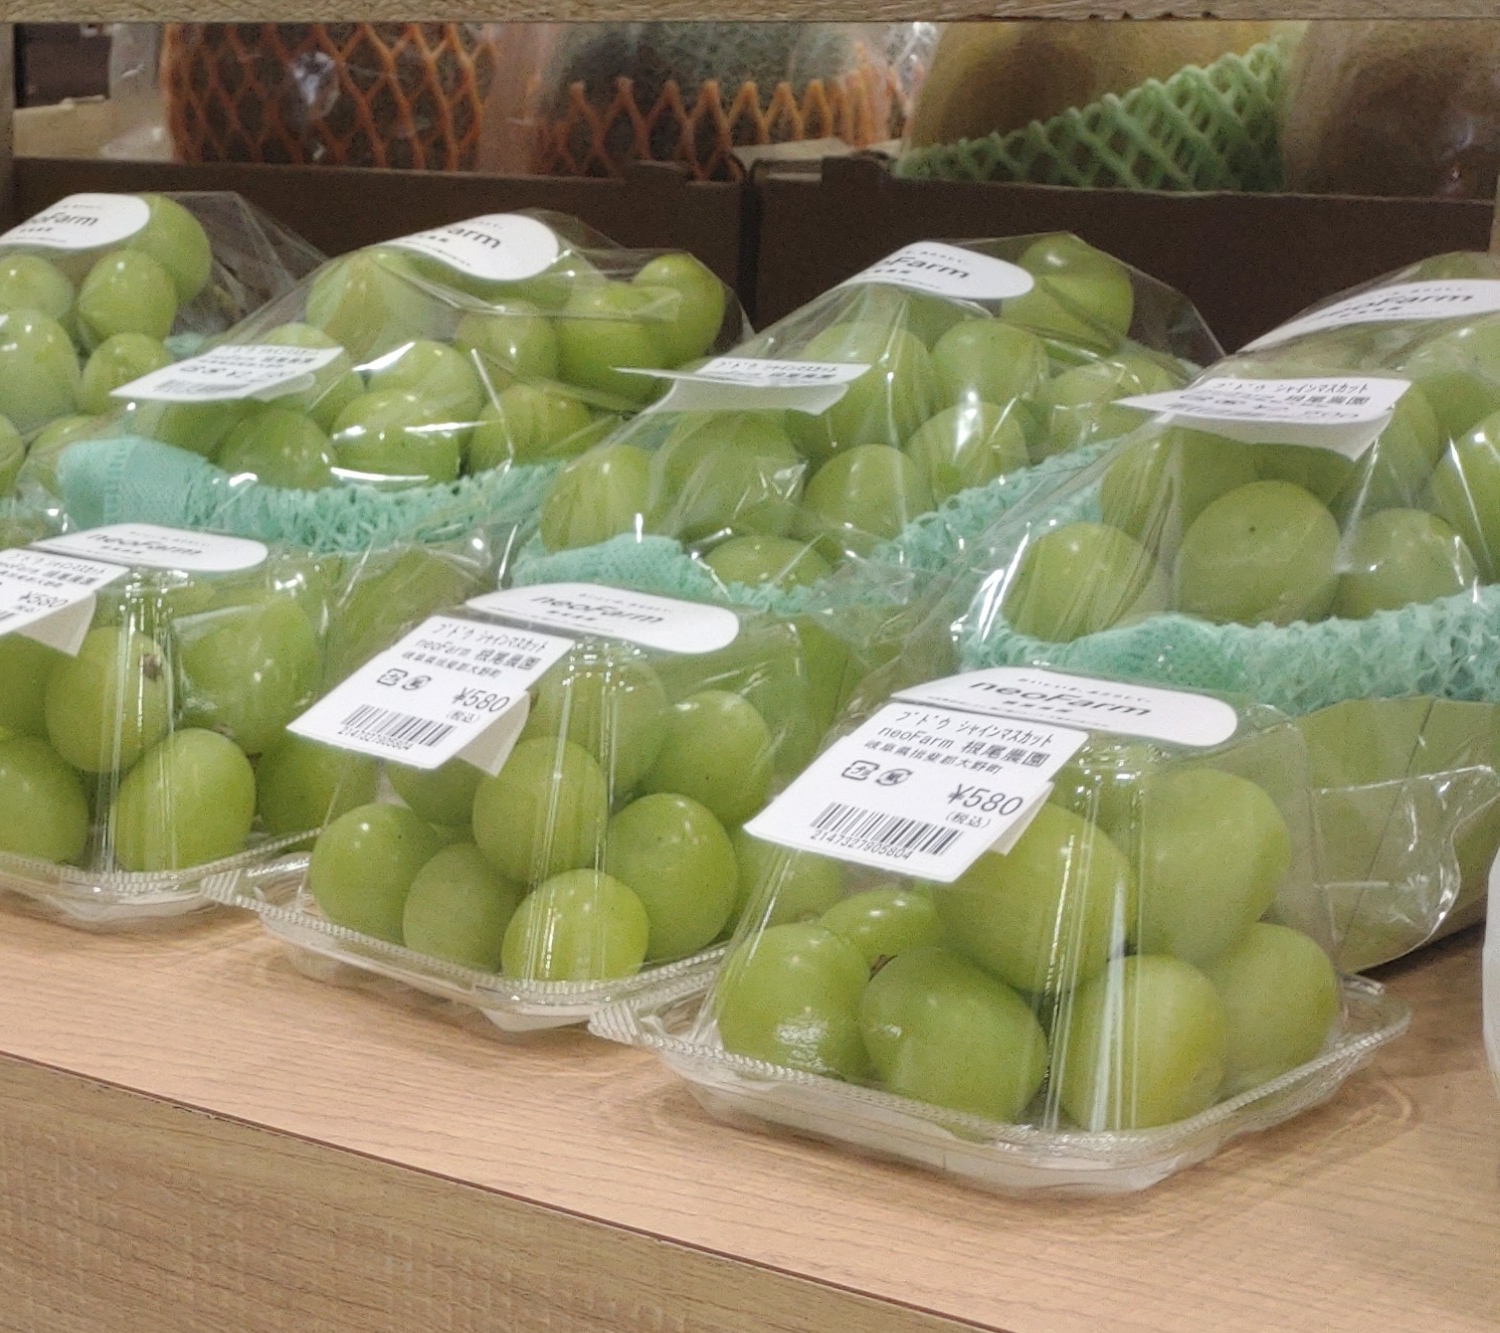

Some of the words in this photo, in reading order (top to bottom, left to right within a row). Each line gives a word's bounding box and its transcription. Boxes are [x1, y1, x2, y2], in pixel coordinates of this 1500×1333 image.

[530, 594, 665, 626] neoFarm
[453, 686, 511, 713] ¥580
[970, 681, 1152, 717] neoFarm
[896, 710, 951, 730] ブドウ
[955, 720, 1055, 748] シャインマスカット
[877, 726, 955, 748] neoFarm
[961, 740, 1051, 768] 根尾農園
[948, 783, 1025, 817] ¥580
